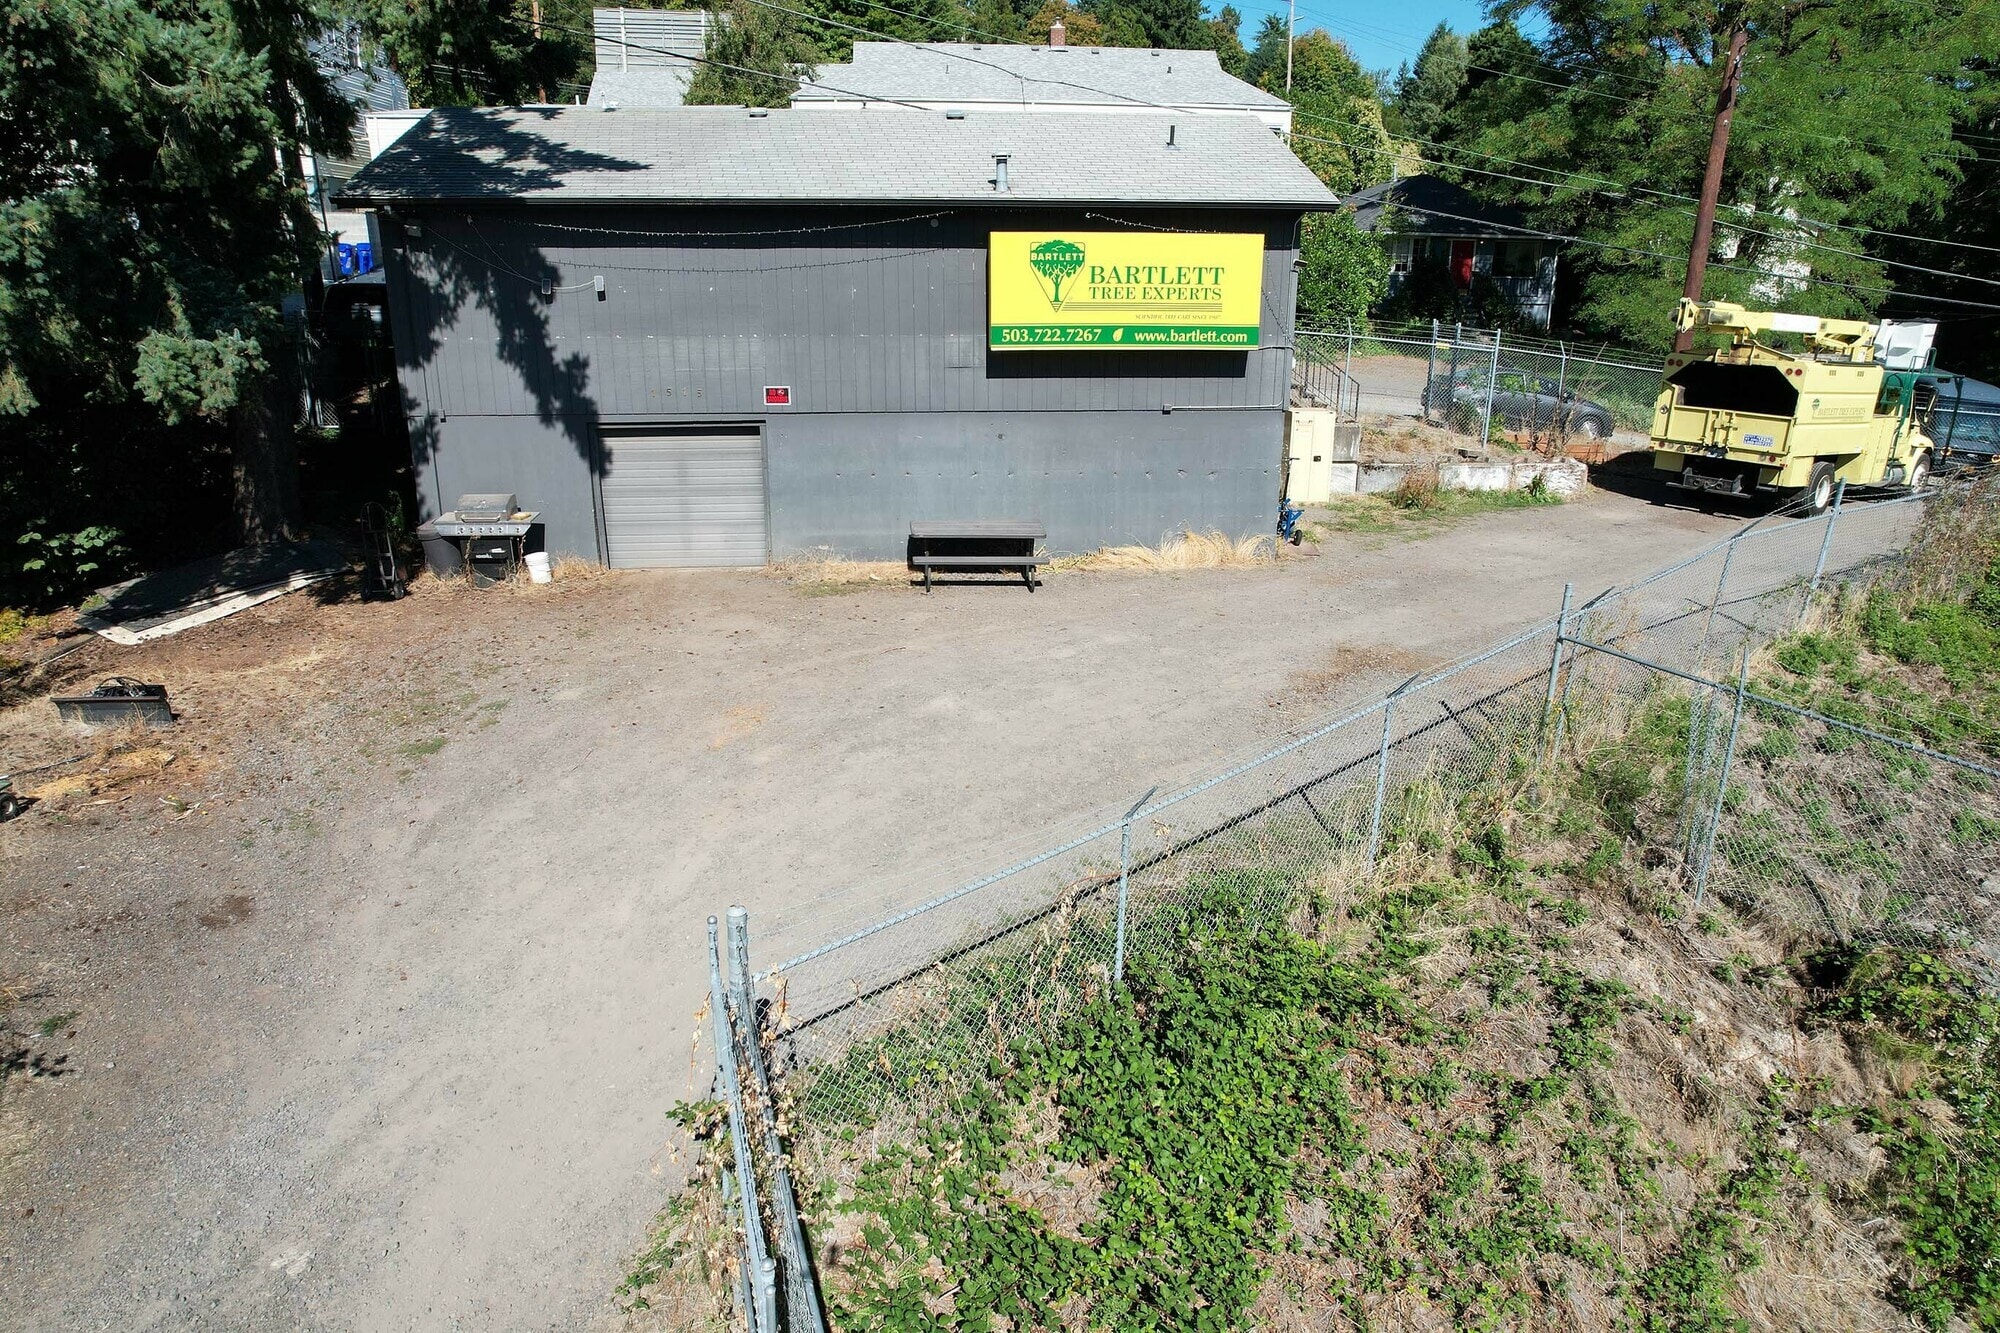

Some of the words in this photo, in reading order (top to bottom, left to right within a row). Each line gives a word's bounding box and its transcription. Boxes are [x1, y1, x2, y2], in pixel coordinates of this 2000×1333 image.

[1030, 252, 1085, 262] BARTLETT
[1089, 265, 1225, 286] BARTLETT
[1089, 286, 1136, 300] TREE
[1142, 287, 1222, 301] EXPERTS
[1001, 328, 1102, 342] 503.722.7267
[1134, 329, 1248, 344] www.bartlett.com
